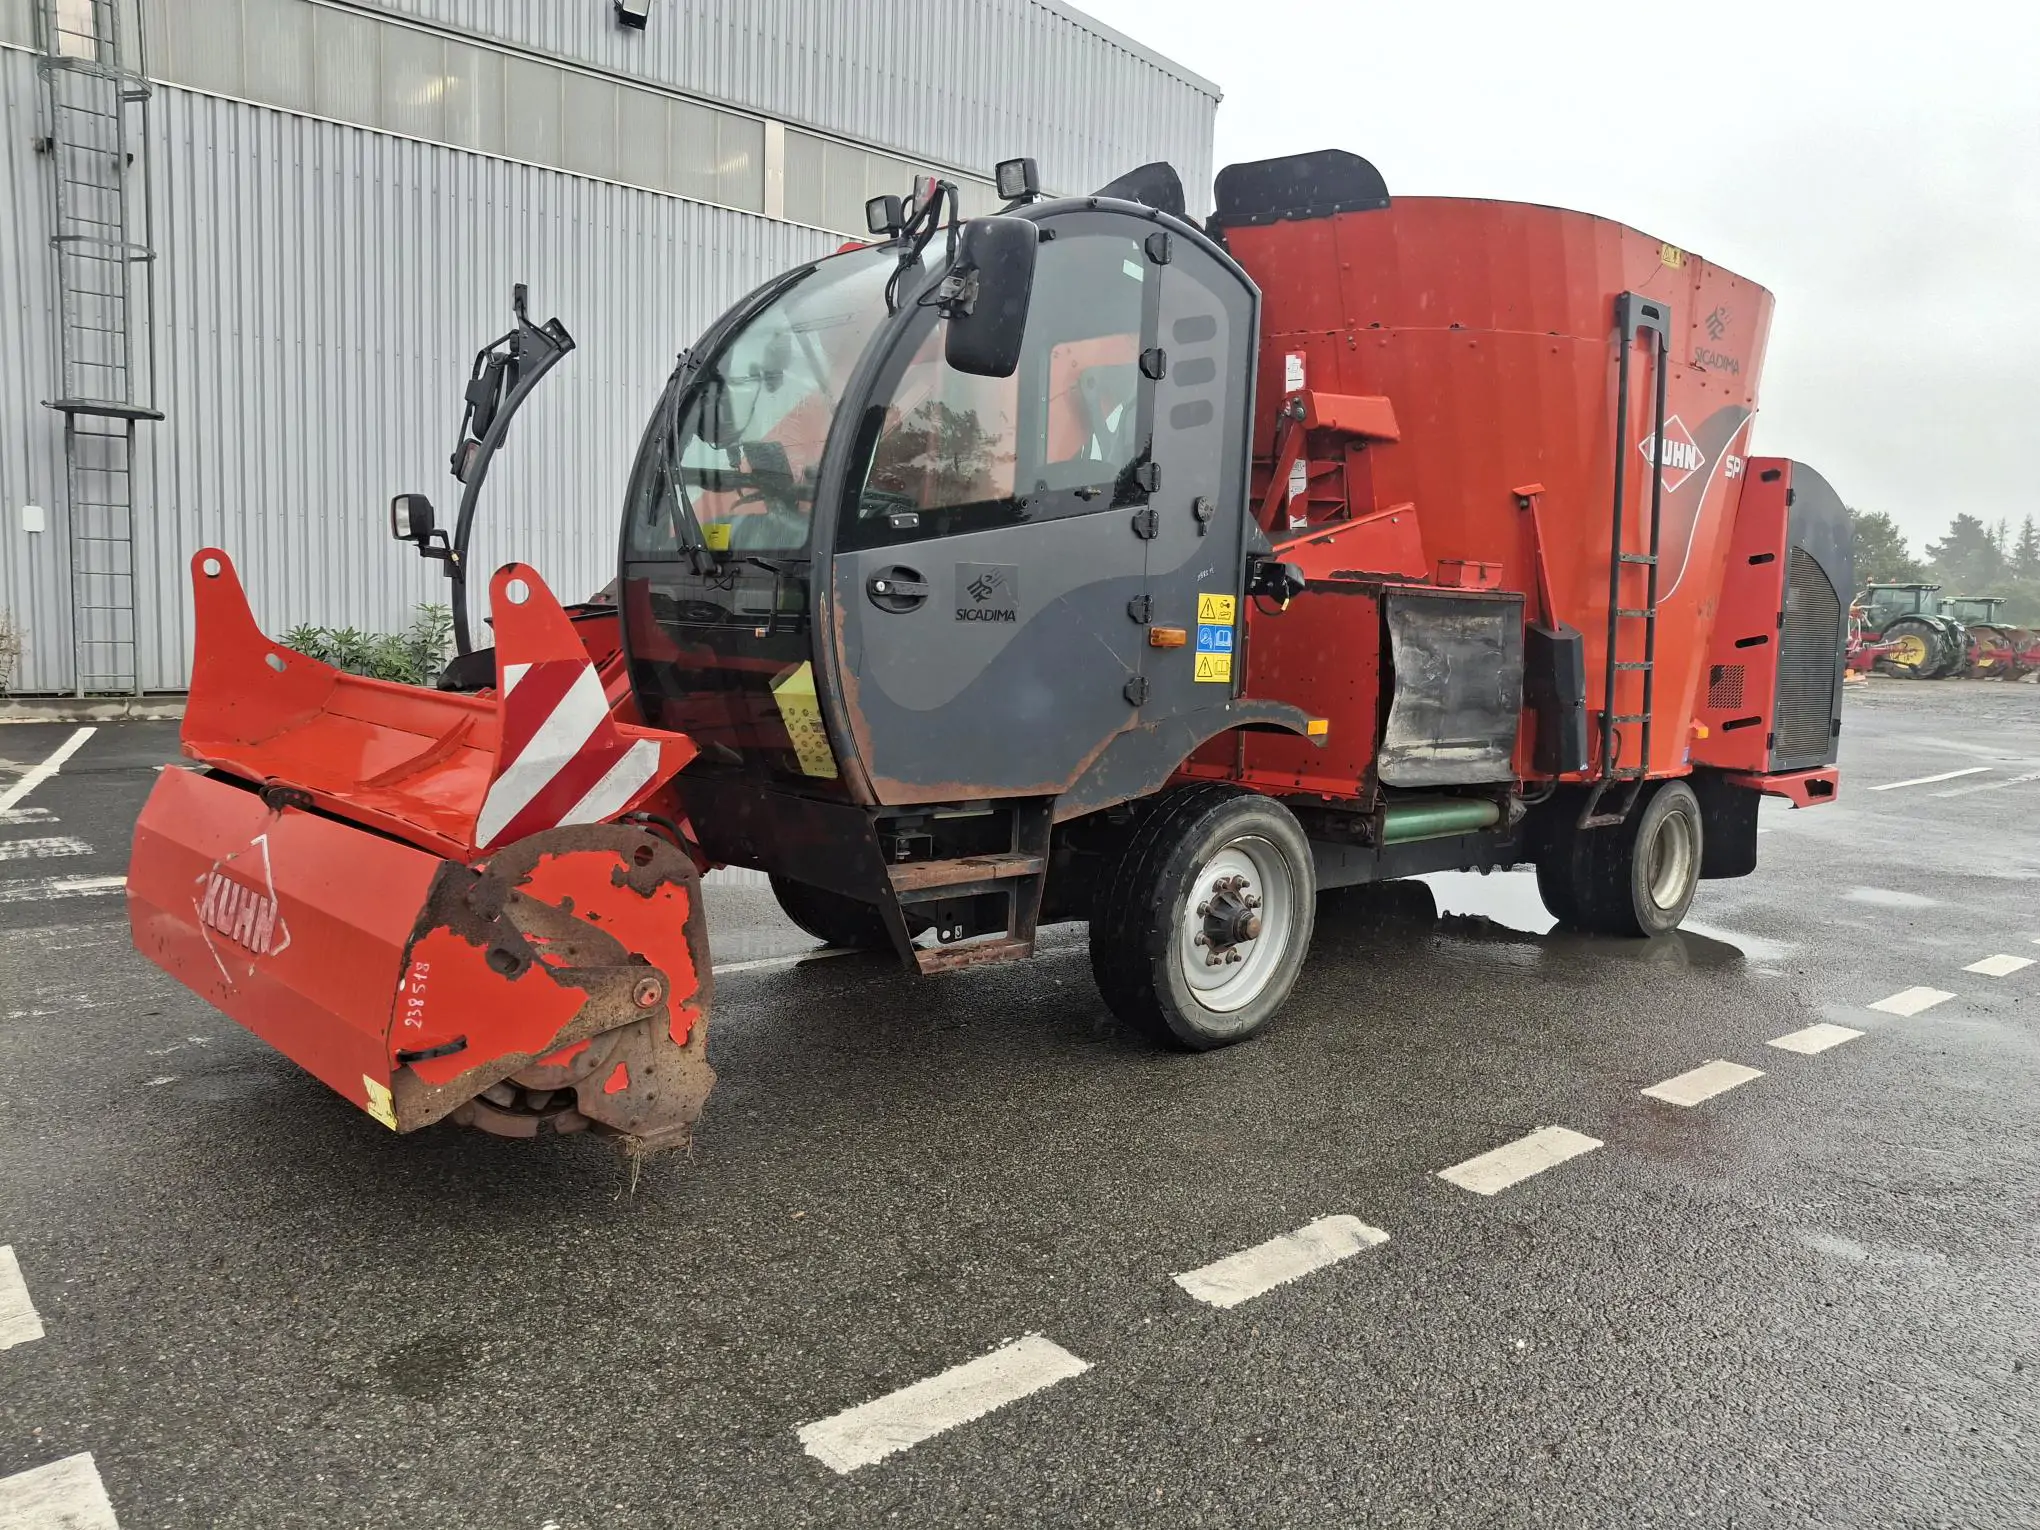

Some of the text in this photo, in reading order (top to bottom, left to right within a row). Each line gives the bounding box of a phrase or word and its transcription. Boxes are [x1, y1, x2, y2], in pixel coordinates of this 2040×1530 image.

[1694, 346, 1740, 376] SICADIMA
[955, 608, 1016, 622] SICADIMA
[199, 871, 278, 954] KUHN
